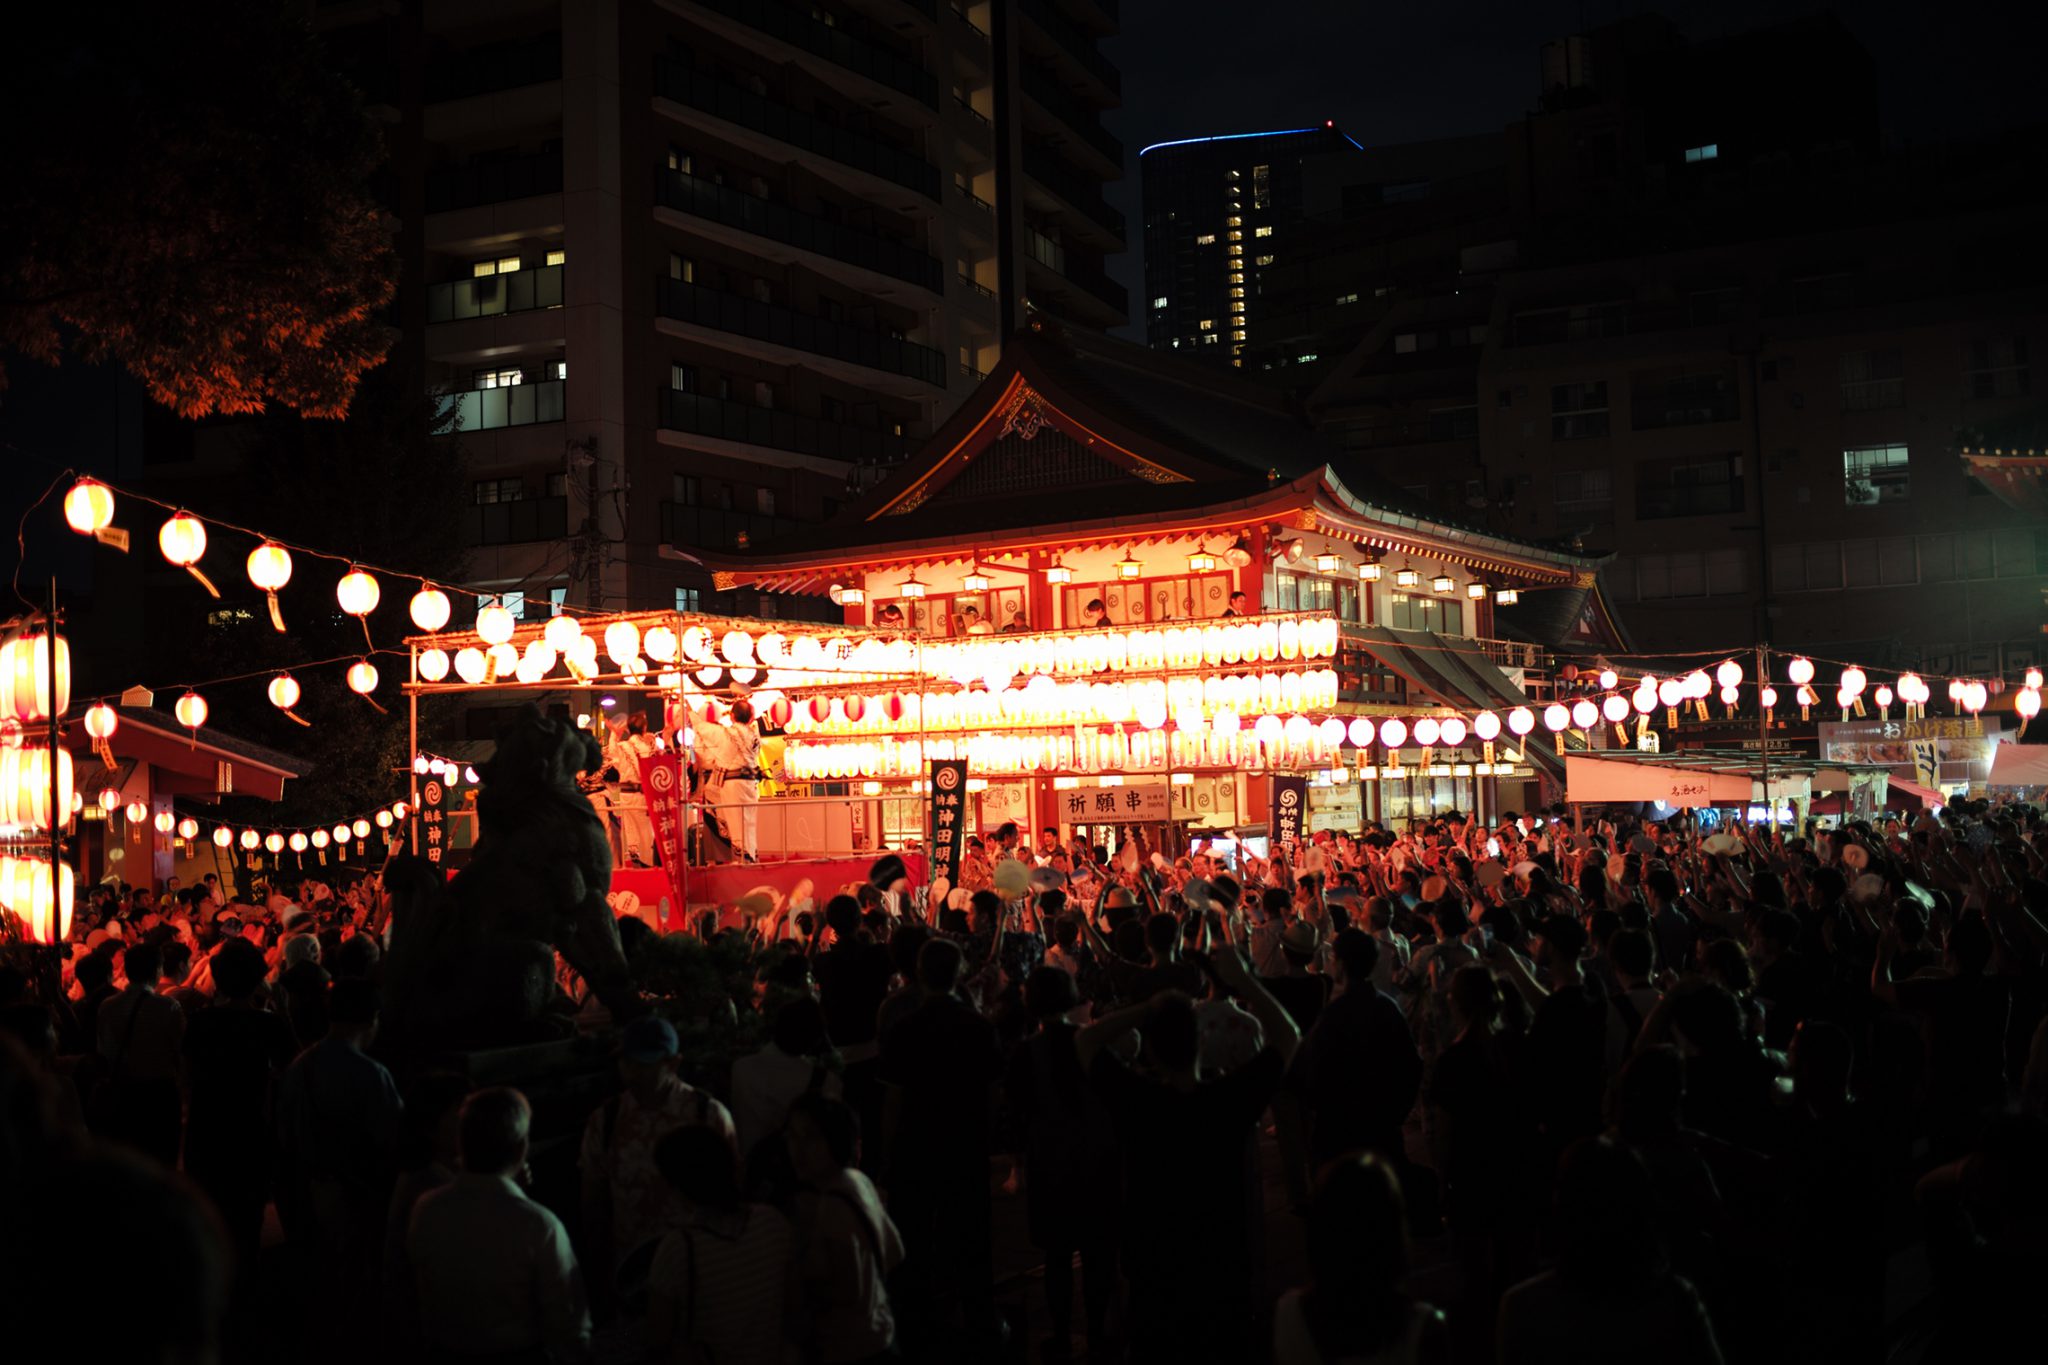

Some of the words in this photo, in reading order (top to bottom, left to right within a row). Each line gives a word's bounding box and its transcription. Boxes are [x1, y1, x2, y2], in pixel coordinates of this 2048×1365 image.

[1883, 719, 1985, 740] おかげ茶屋
[1067, 790, 1142, 815] 祈願串
[934, 809, 955, 879] 神田明神
